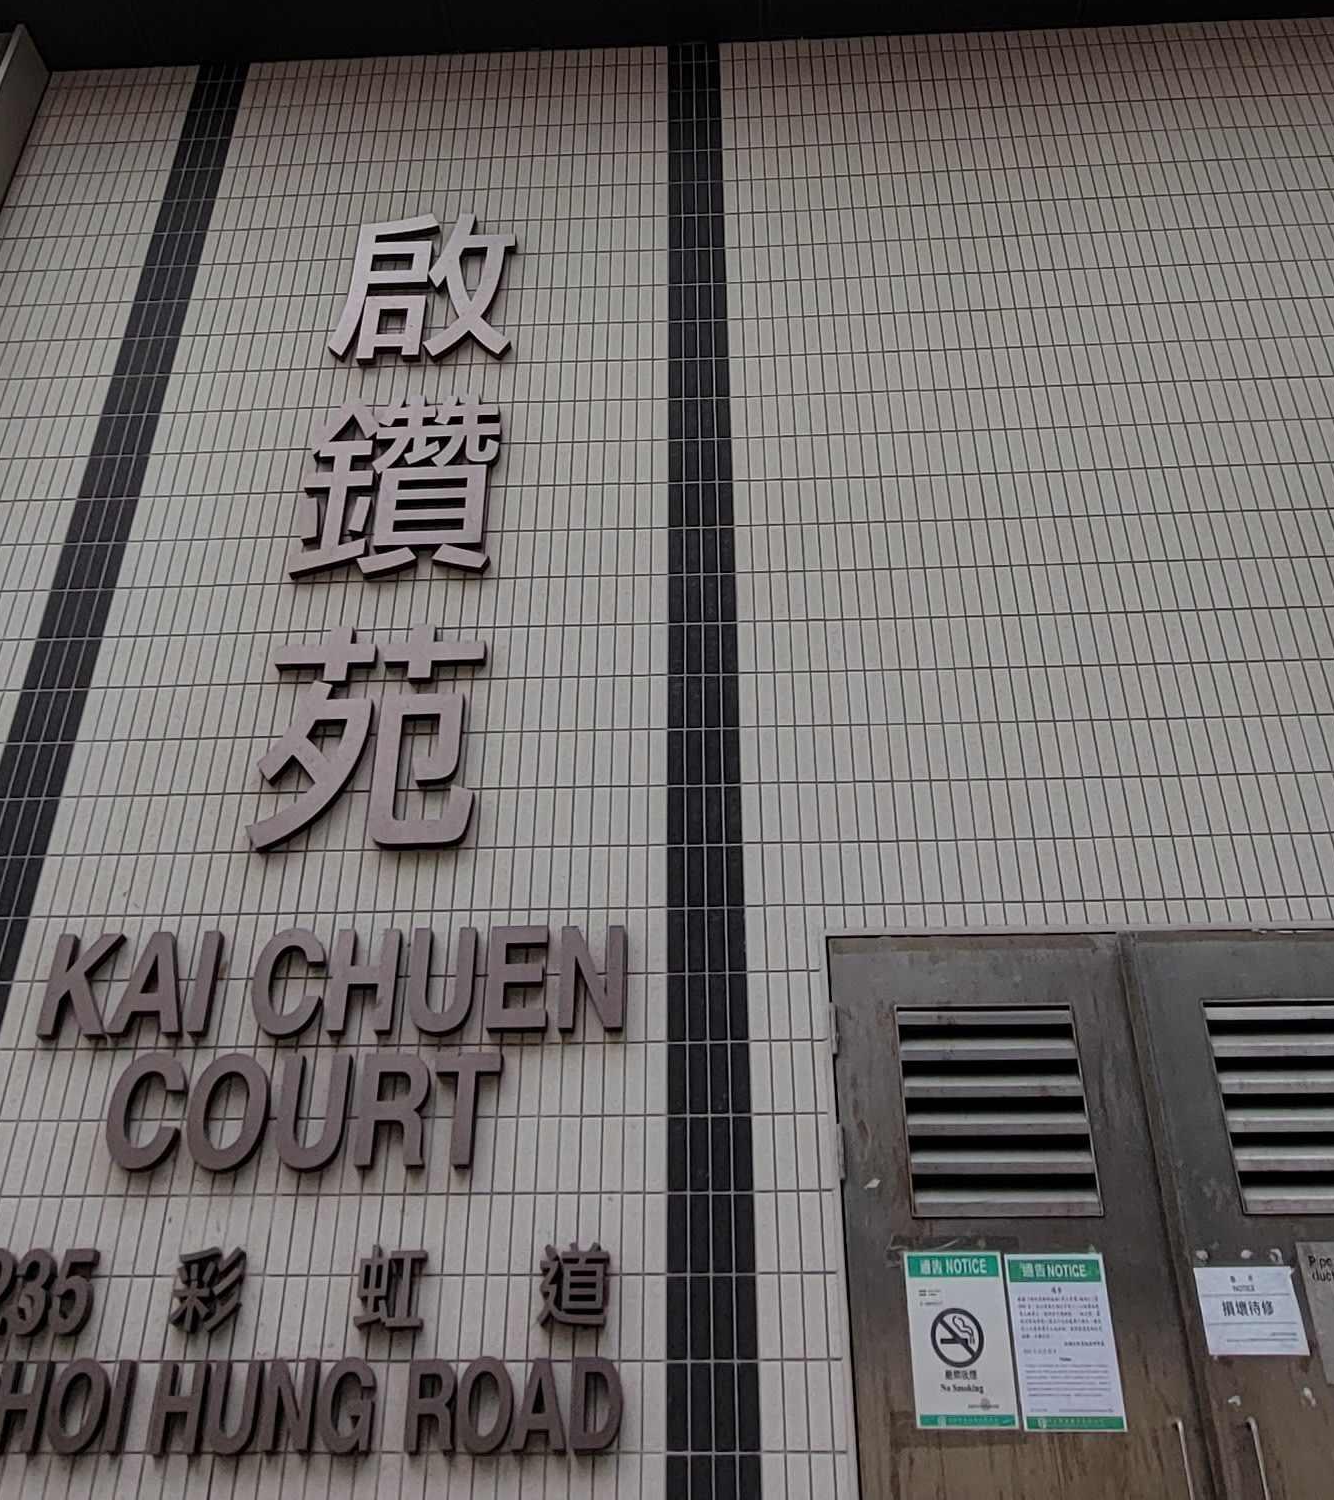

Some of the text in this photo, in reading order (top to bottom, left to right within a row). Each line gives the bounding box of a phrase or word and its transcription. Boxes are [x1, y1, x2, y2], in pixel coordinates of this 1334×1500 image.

[249, 213, 517, 853] 啟鑽苑
[37, 925, 627, 1039] KAI CHUEN
[107, 1052, 503, 1172] COURT
[946, 1258, 988, 1275] NOTICE
[1047, 1263, 1087, 1278] NOTICE
[150, 1356, 377, 1455] HUNG
[404, 1356, 624, 1452] ROAD
[940, 1383, 984, 1394] No Smoking
